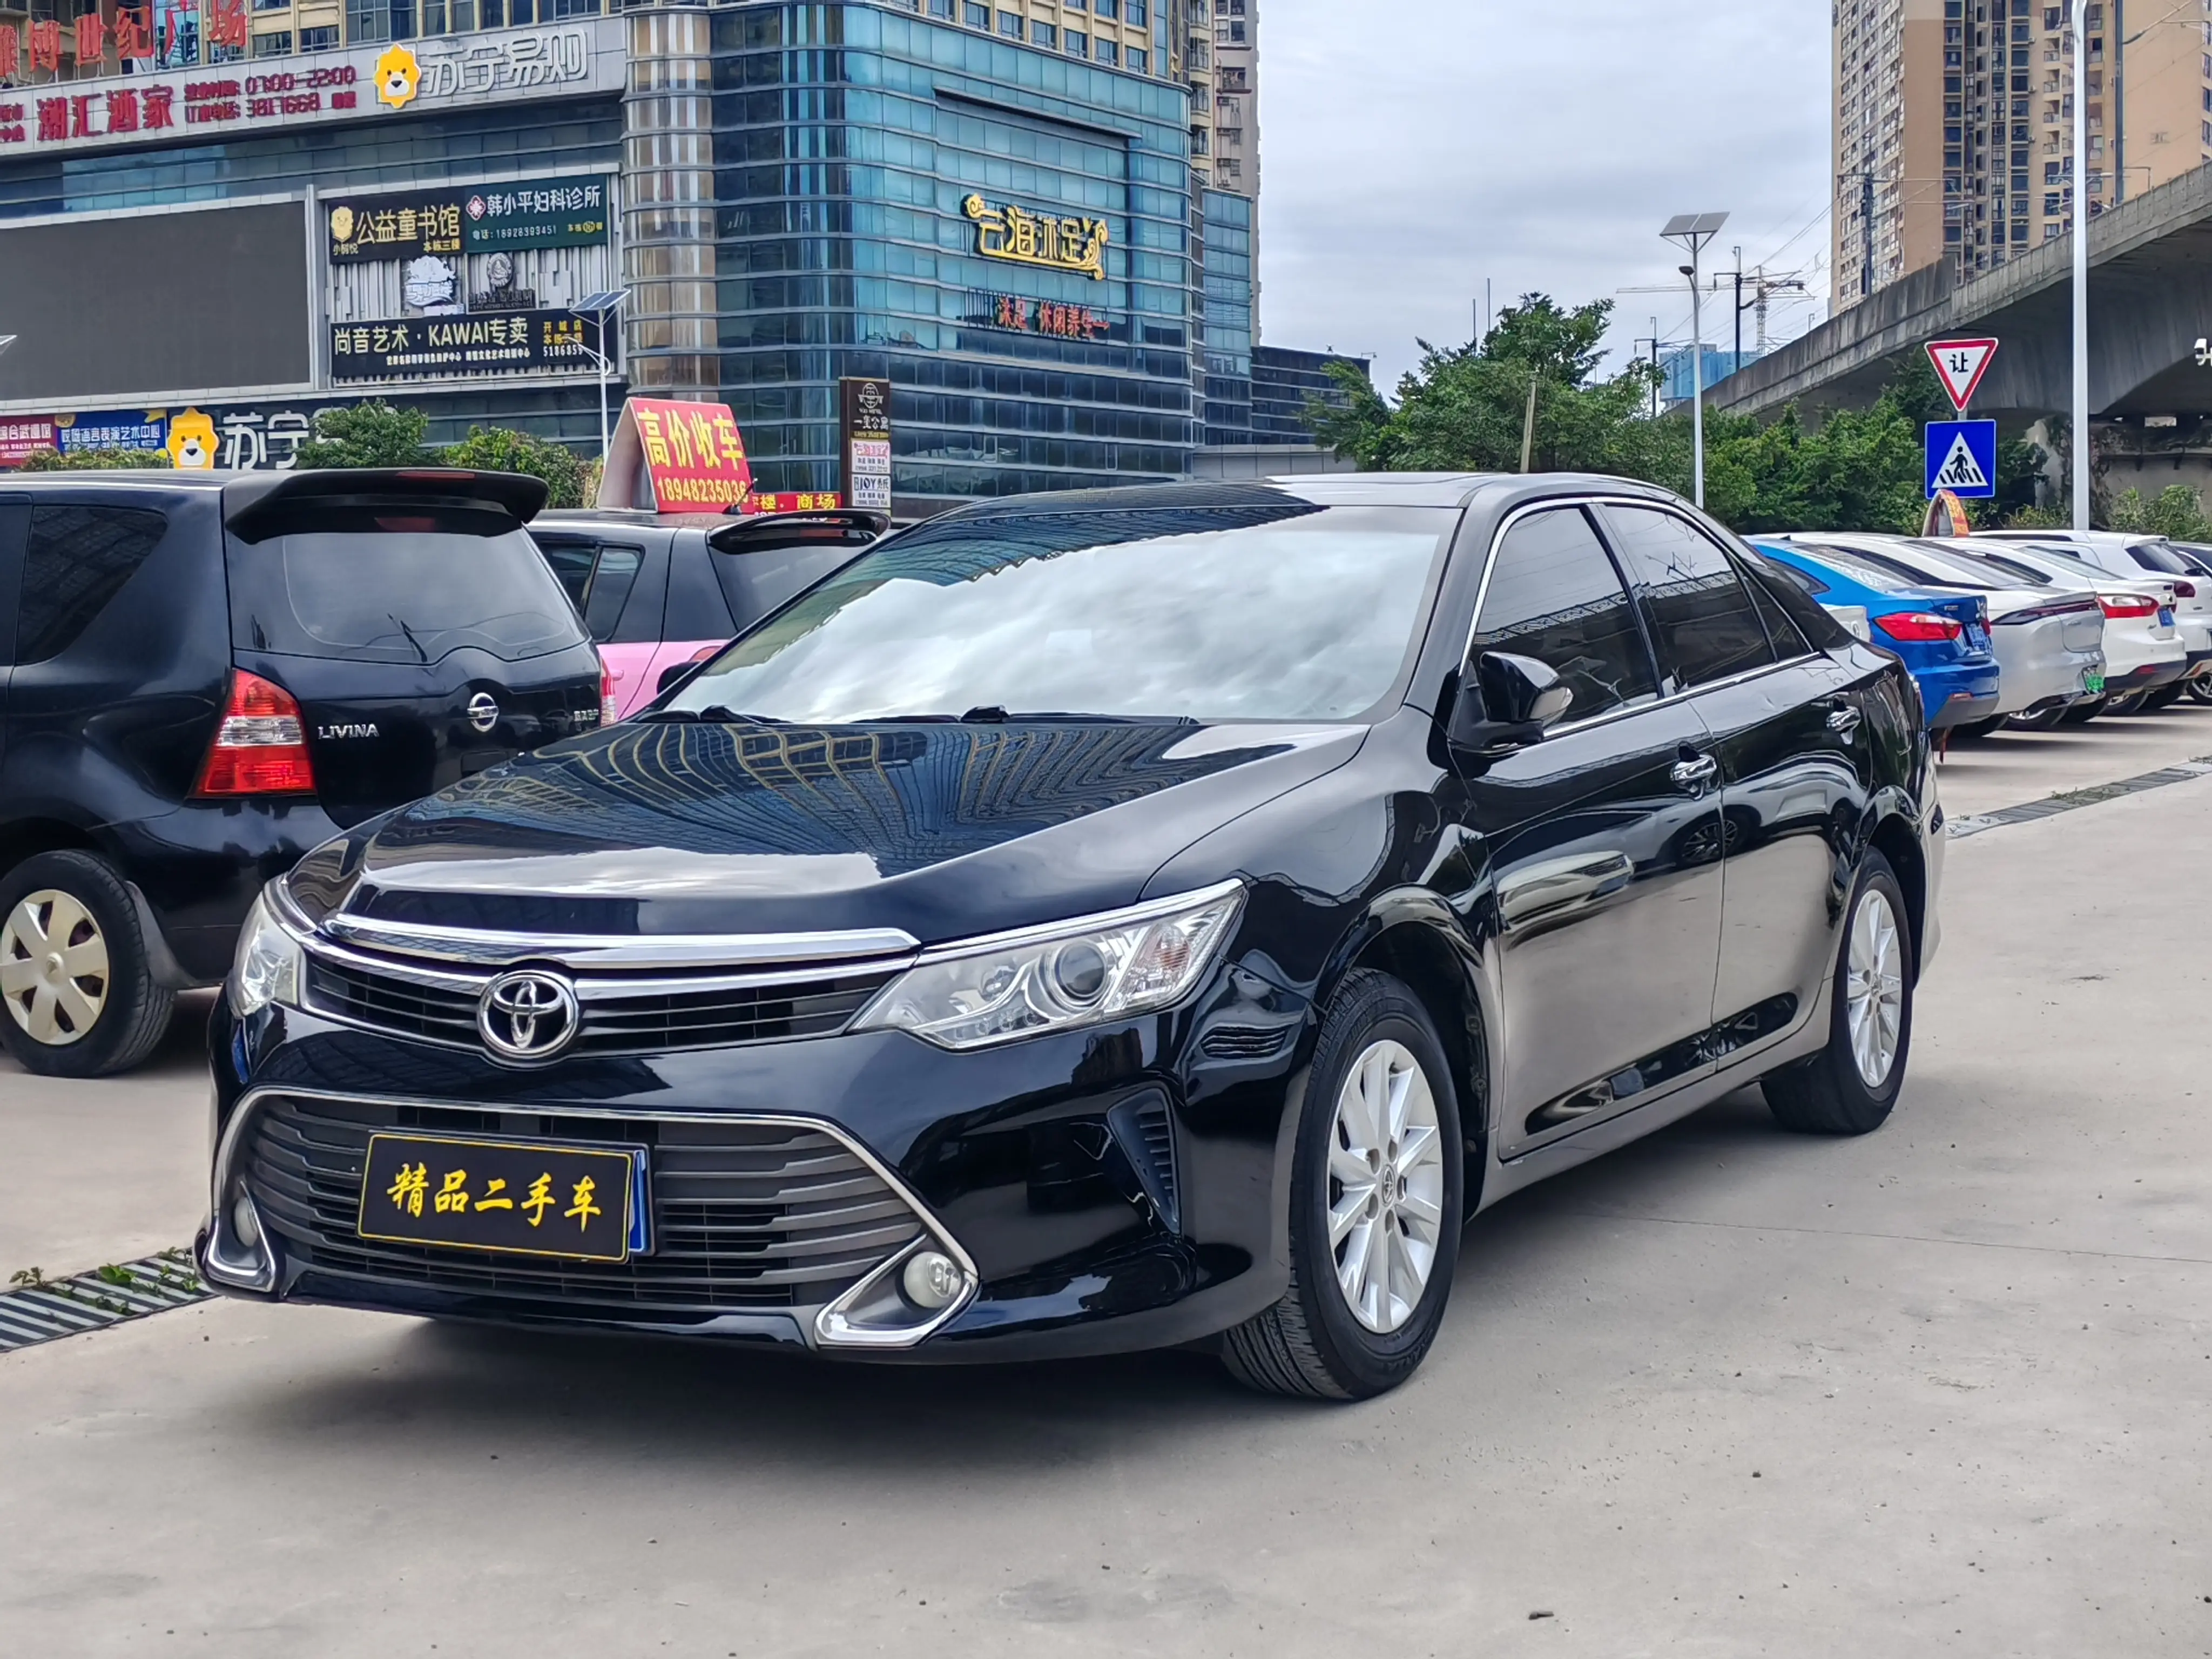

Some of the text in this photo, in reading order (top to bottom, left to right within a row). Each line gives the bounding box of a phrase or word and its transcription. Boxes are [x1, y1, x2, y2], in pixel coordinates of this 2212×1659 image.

[426, 28, 588, 96] 苏宁易购
[36, 84, 173, 141] 潮汇酒家
[356, 203, 460, 244] 公益童书馆
[487, 185, 601, 217] 韩小平妇科诊所
[1949, 352, 1969, 373] 让
[222, 406, 352, 471] 苏宁
[637, 408, 744, 471] 高价收车
[318, 723, 379, 740] LIVINA
[387, 1162, 601, 1232] 精品二手车
